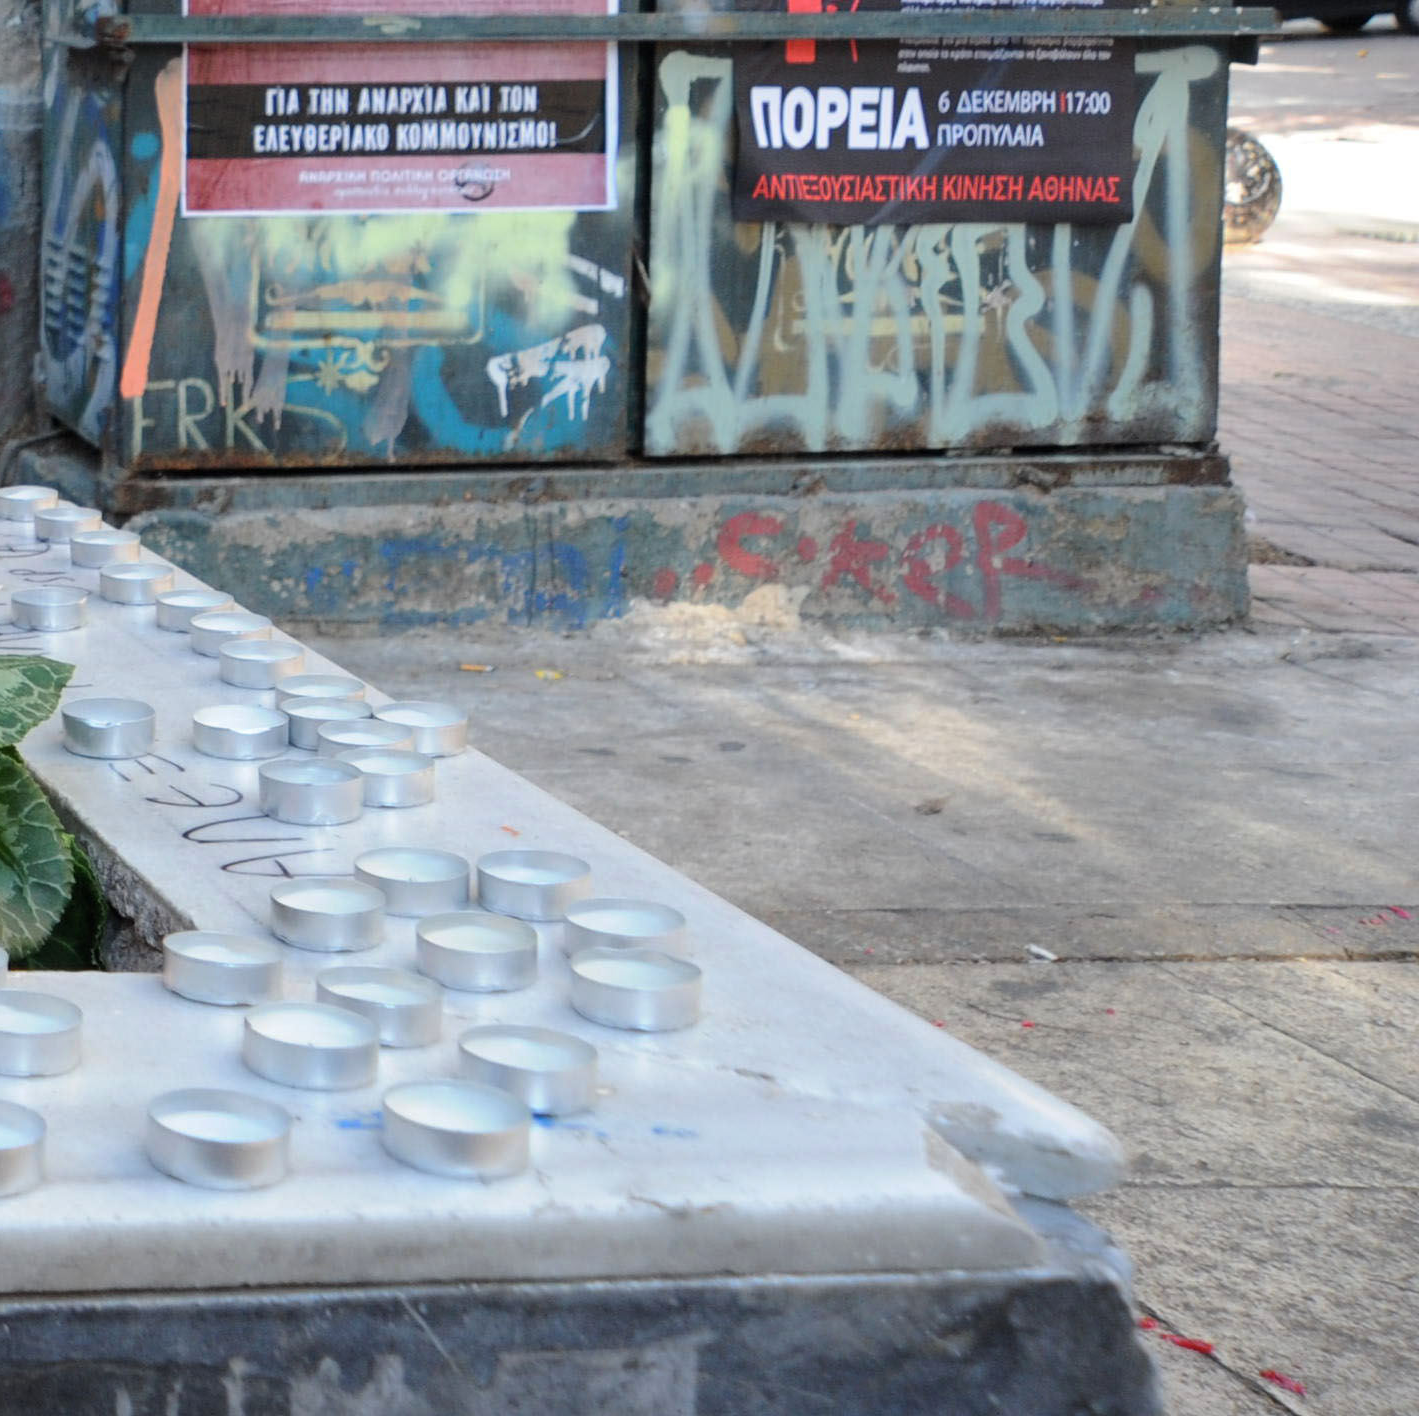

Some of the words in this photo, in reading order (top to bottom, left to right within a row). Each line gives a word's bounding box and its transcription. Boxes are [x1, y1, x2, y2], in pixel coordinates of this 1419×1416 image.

[307, 87, 350, 116] ΤΗΝ
[498, 85, 539, 113] ΤΟΝ
[749, 85, 930, 150] ΠΟΡΕΙΑ
[937, 89, 950, 114] 6
[956, 89, 1057, 115] ΔΕΚΕΜΒΡΗ
[936, 122, 1045, 148] ΠΡΟΠΥΛΑΙΑ
[751, 172, 937, 203] ΑΝΤΙΕΞΟΥΣΙΑΣΤΙΚΗ
[941, 173, 1023, 202] ΚΙΝΗΣΗ
[1027, 174, 1122, 204] ΑΘΗΝΑΣ
